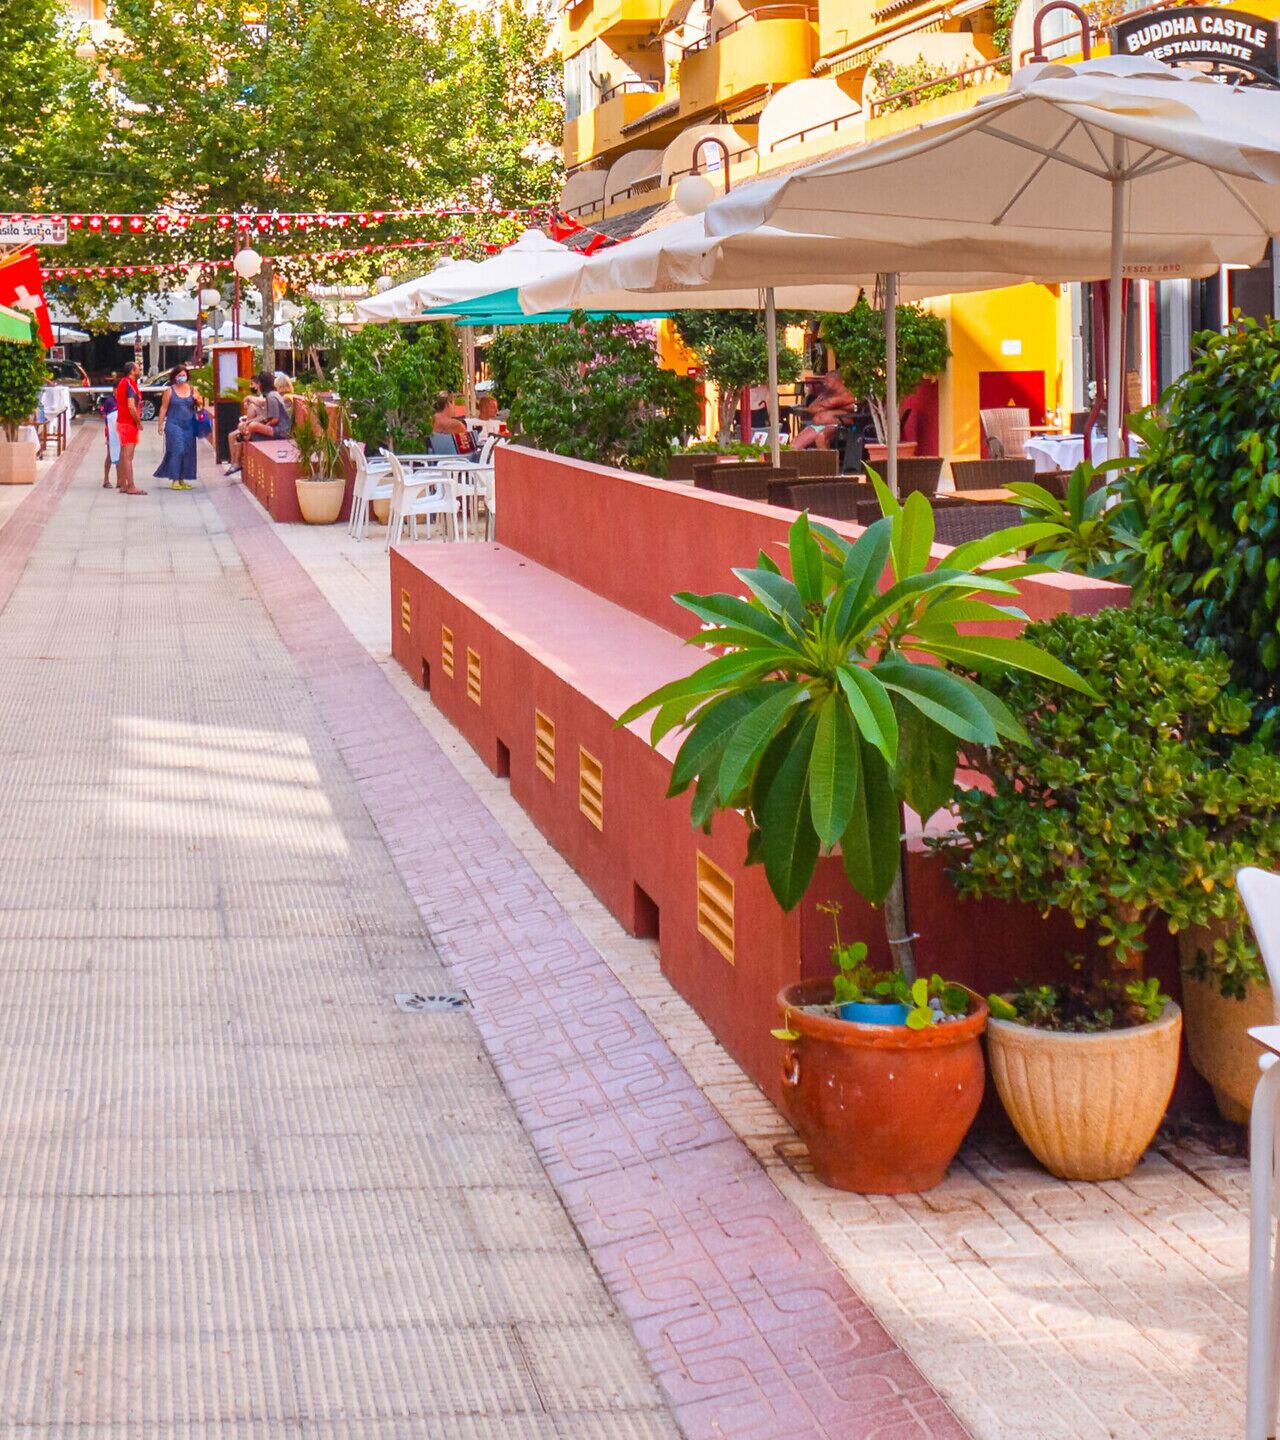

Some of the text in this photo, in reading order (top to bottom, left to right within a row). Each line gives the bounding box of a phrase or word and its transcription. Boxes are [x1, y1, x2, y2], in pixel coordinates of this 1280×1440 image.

[1126, 16, 1268, 53] BUDDHA CASTLE
[1143, 40, 1253, 61] RESTAURANTE
